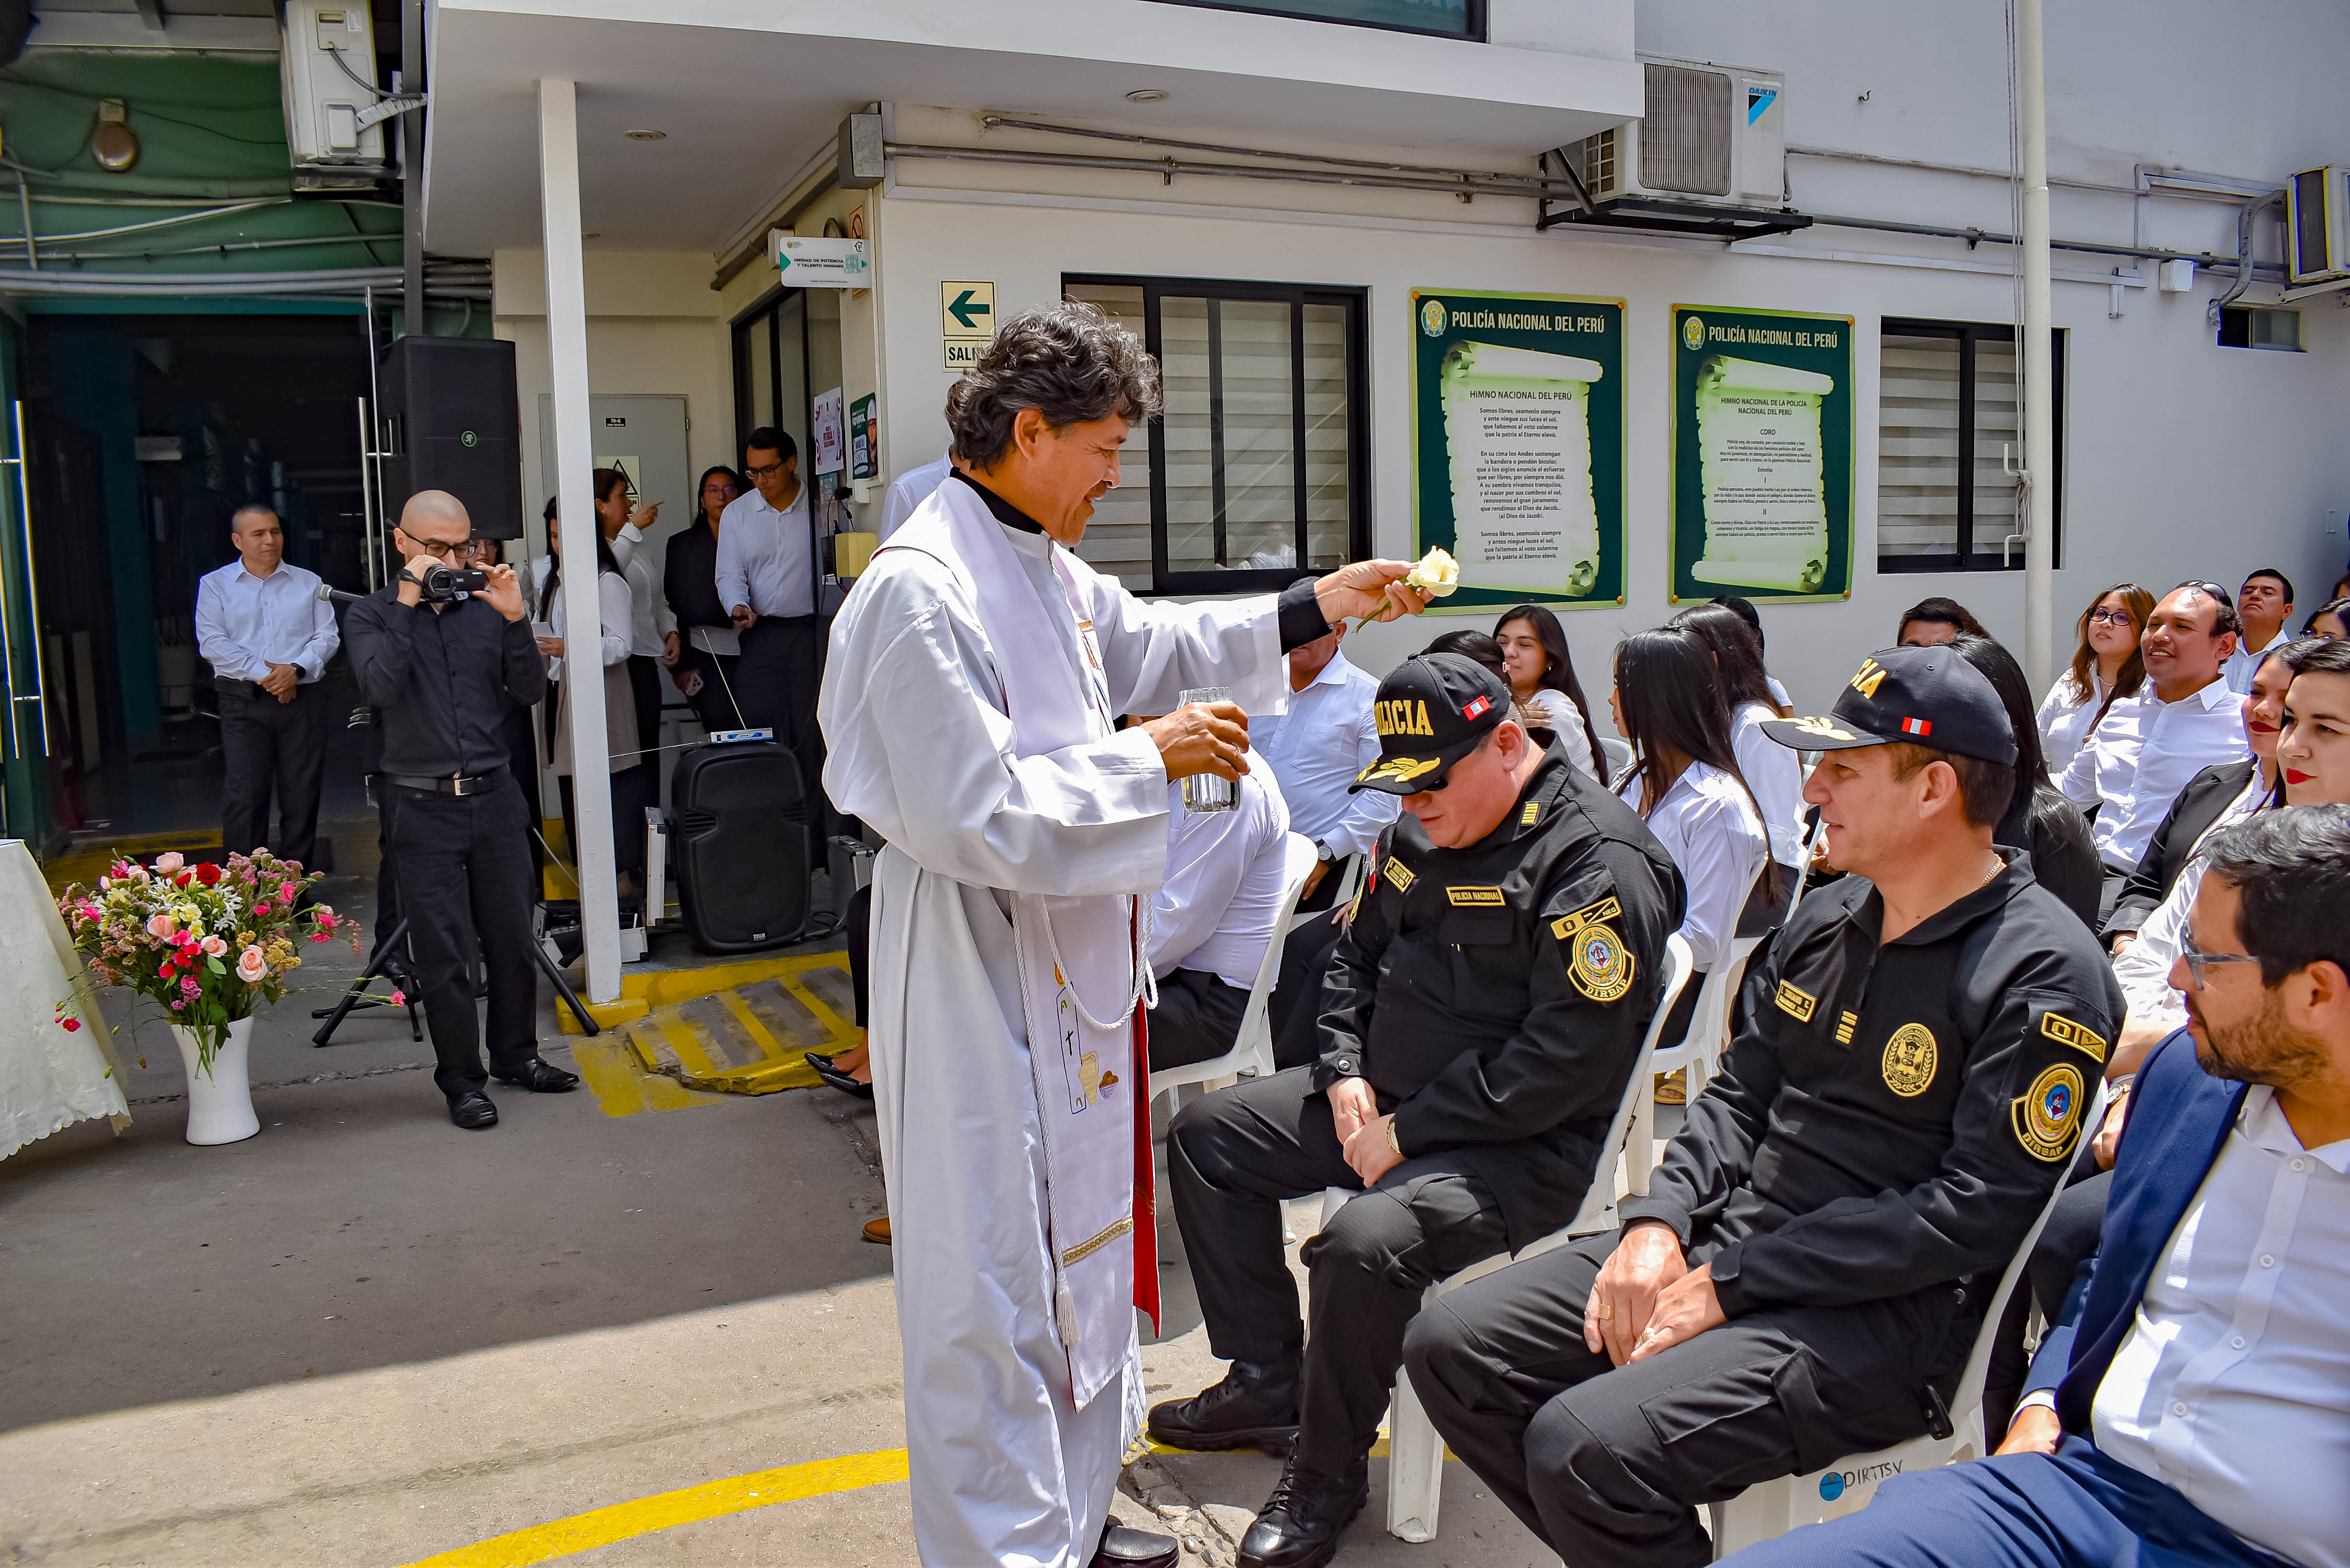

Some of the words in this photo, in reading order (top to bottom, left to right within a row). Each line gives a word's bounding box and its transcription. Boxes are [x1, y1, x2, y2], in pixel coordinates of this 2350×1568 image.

[1749, 87, 1777, 97] DAIKIN
[1453, 309, 1494, 328] POLICÍA
[1499, 313, 1551, 330] NACIONAL
[1555, 316, 1574, 331] DEL
[1577, 314, 1604, 332] PERÚ
[1709, 325, 1745, 342] POLICÍA
[1748, 329, 1793, 345] NACIONAL
[1795, 332, 1812, 347] DEL
[1814, 331, 1837, 348] PERÚ
[1470, 390, 1496, 398] HIMNO
[1553, 391, 1572, 400] PERÚ
[1451, 892, 1472, 901] POLICIA
[1472, 892, 1500, 901] NACIONAL
[1603, 907, 1617, 917] NEG
[1585, 979, 1628, 997] DIRBAP
[2022, 1132, 2063, 1157] DIRBAP
